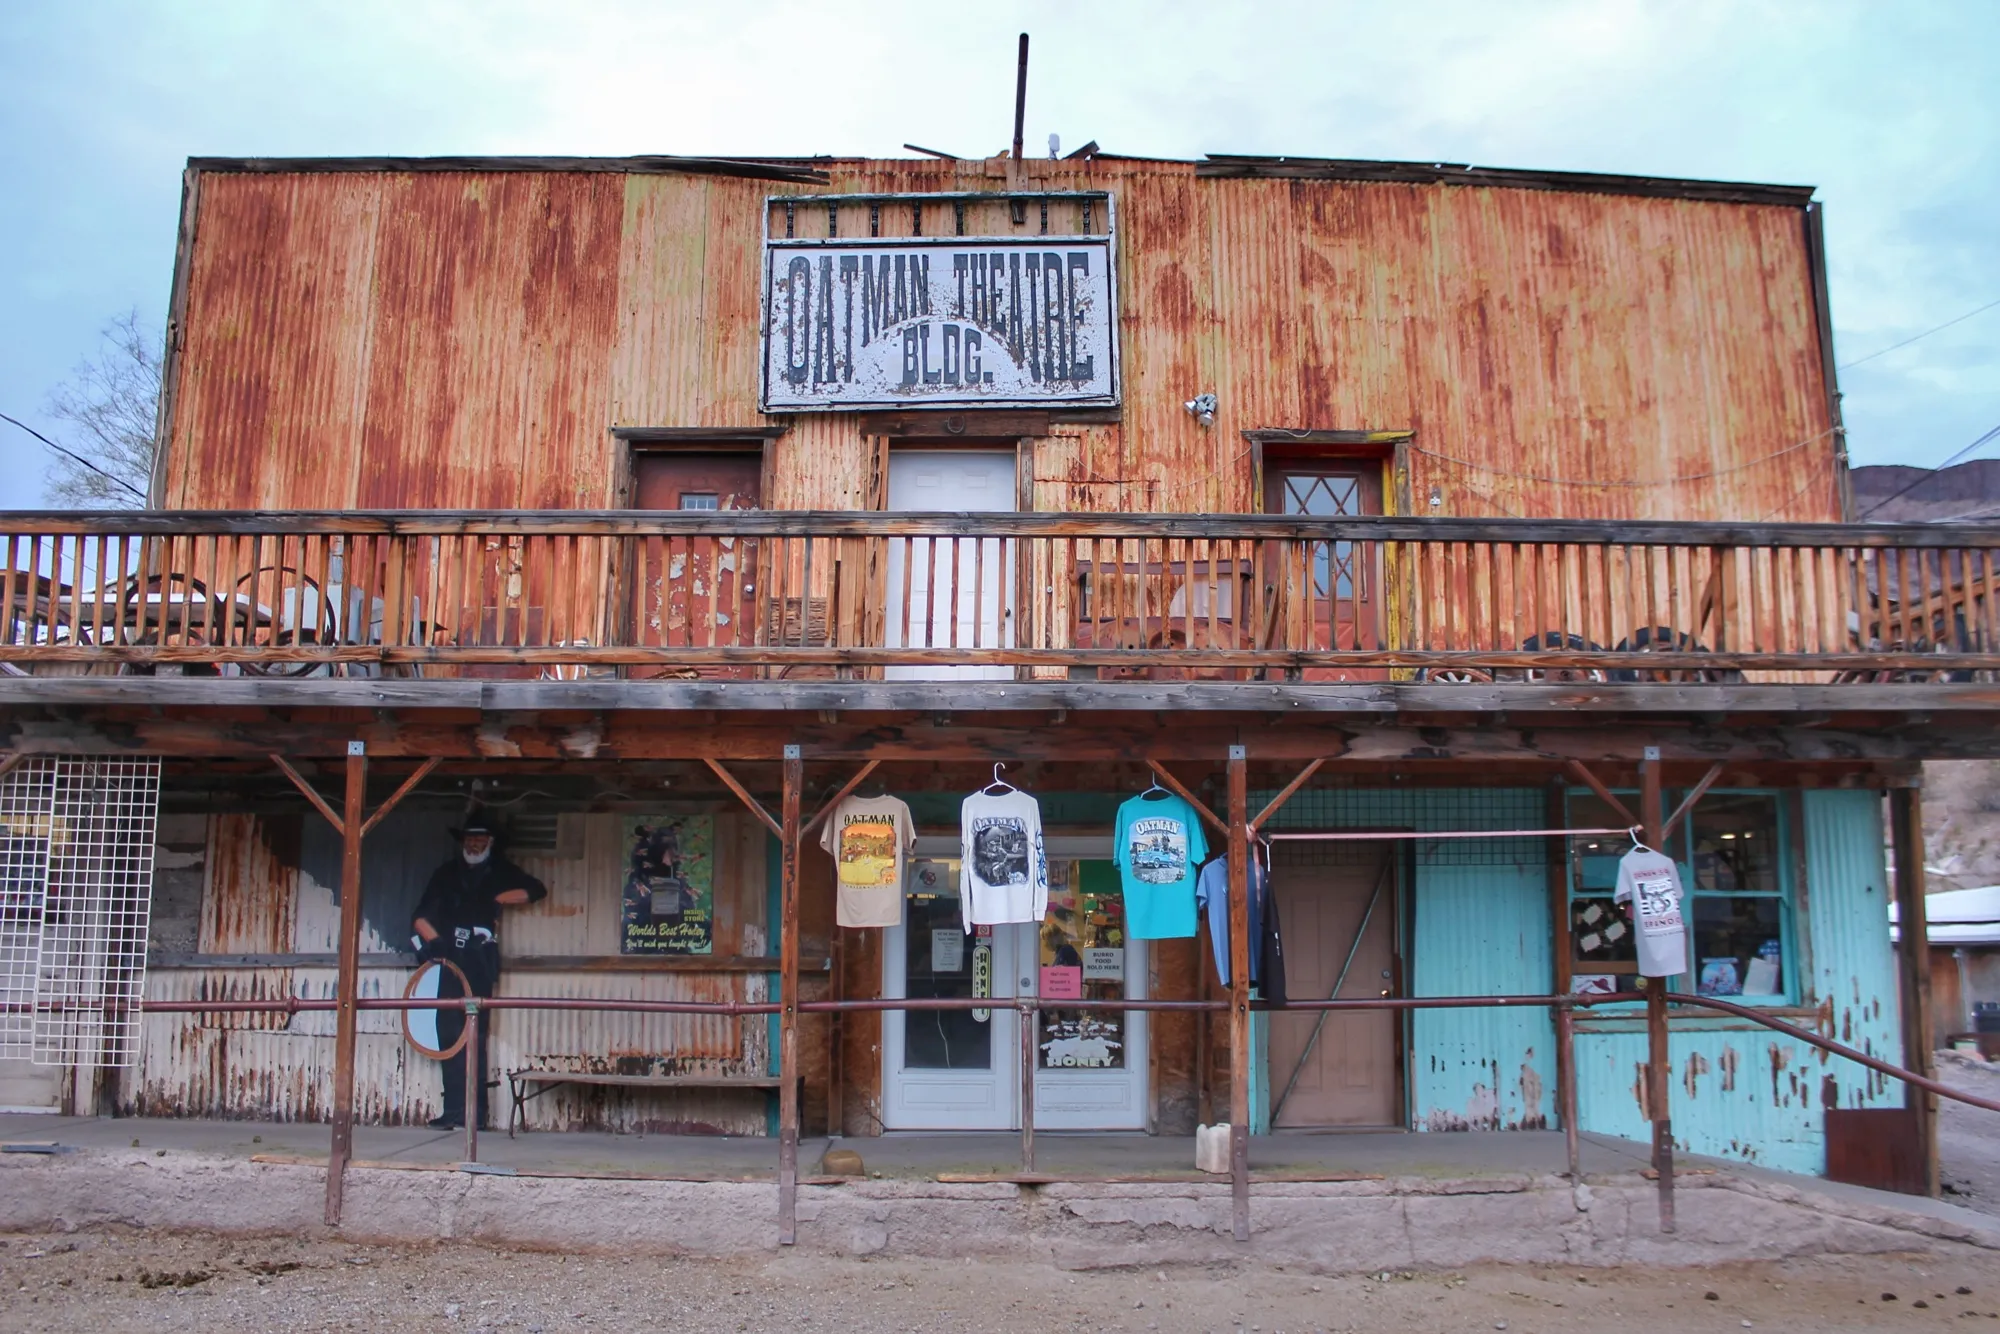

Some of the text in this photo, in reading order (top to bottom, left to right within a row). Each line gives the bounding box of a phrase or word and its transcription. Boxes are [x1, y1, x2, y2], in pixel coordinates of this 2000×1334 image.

[787, 252, 1095, 384] OATMAN THEATRE
[902, 324, 993, 385] BLDG.
[1136, 820, 1180, 835] OATMAN
[627, 923, 657, 936] Worlds
[659, 922, 678, 936] Best
[657, 940, 667, 949] you
[669, 938, 686, 950] bought
[1046, 1056, 1114, 1067] HONEY
